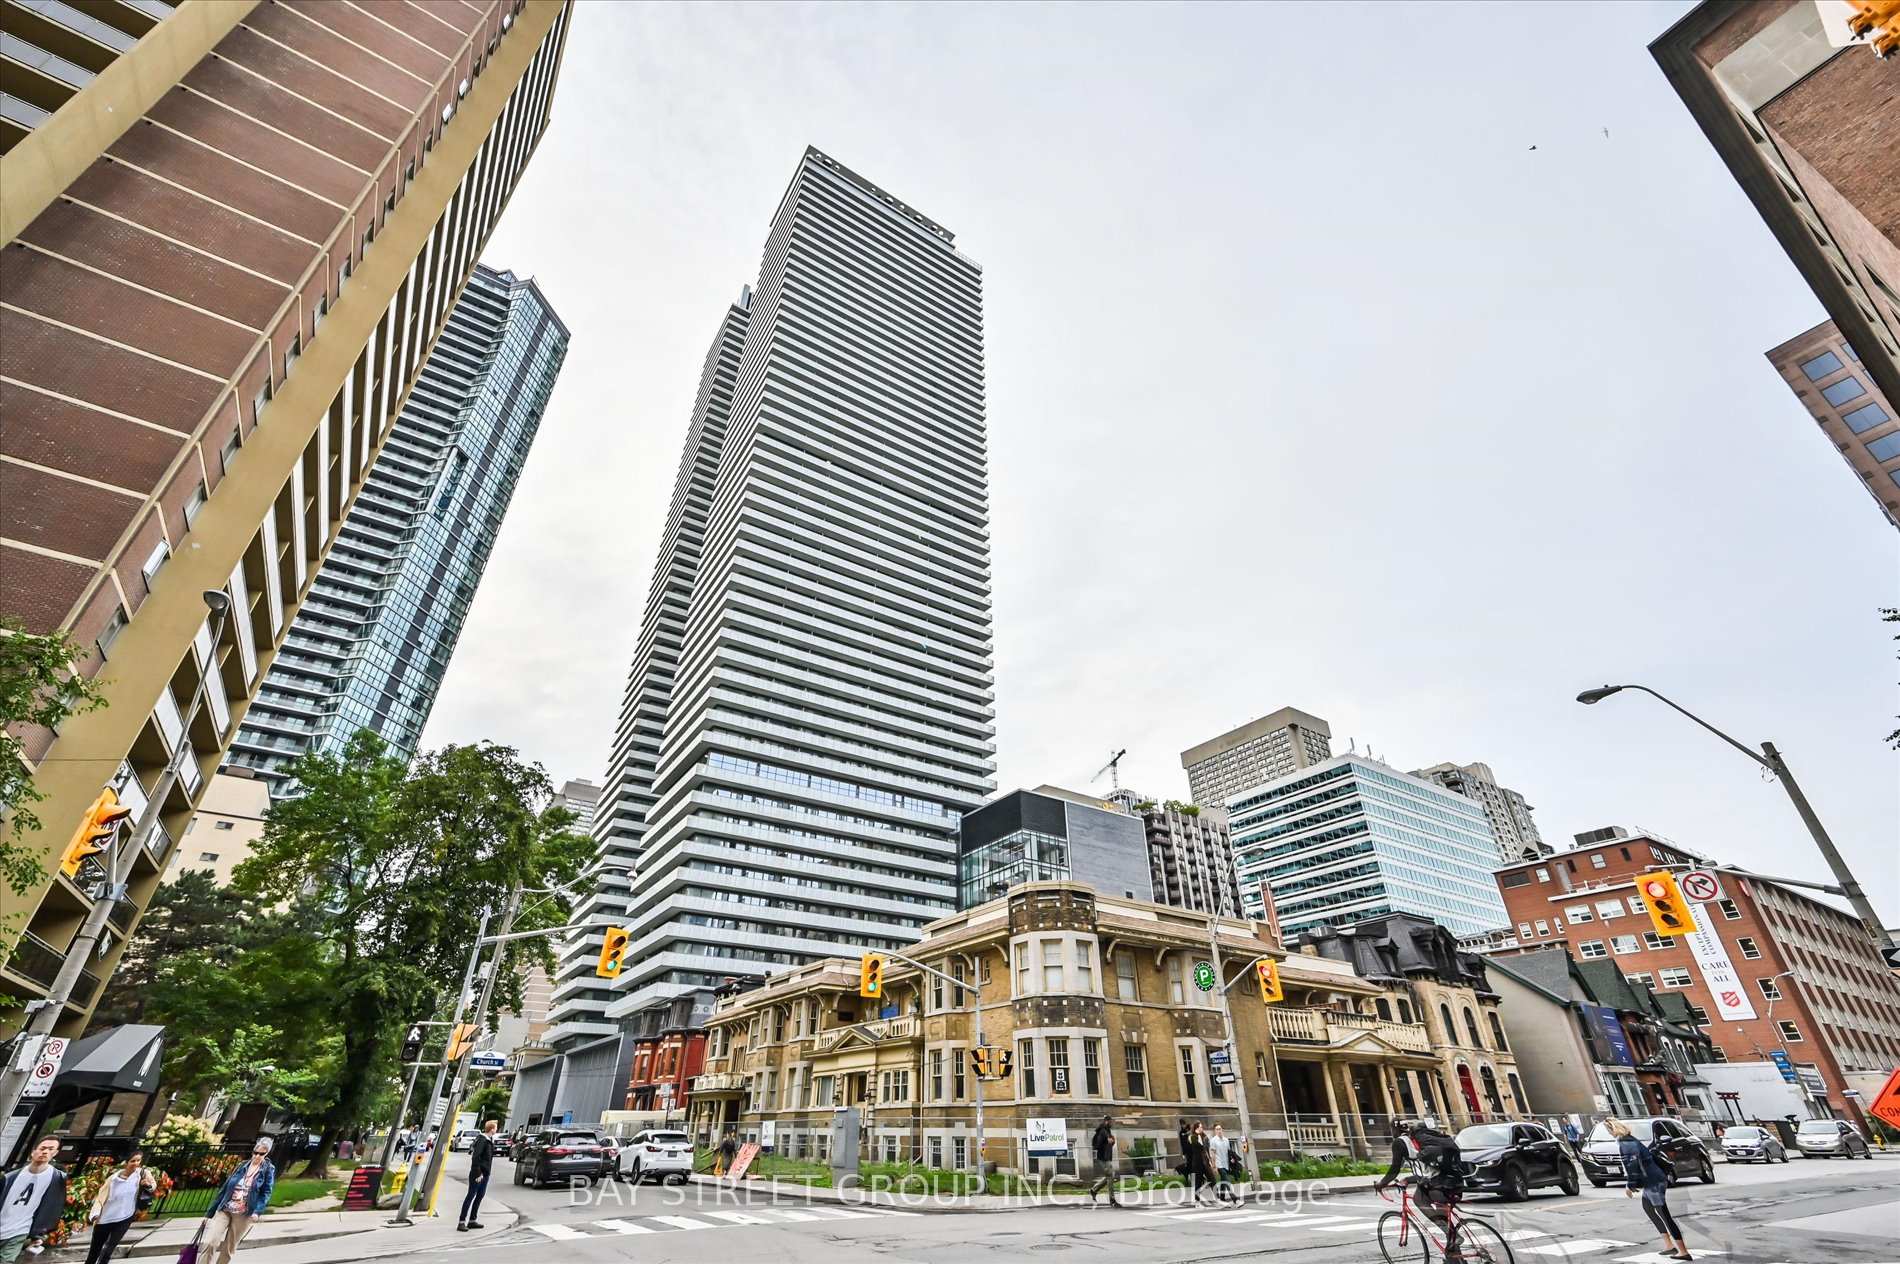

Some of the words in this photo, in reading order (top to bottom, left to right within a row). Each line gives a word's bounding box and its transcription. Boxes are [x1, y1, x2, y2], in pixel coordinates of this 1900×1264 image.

[1701, 960, 1729, 970] CARE
[1200, 970, 1209, 982] P
[13, 1183, 35, 1206] A
